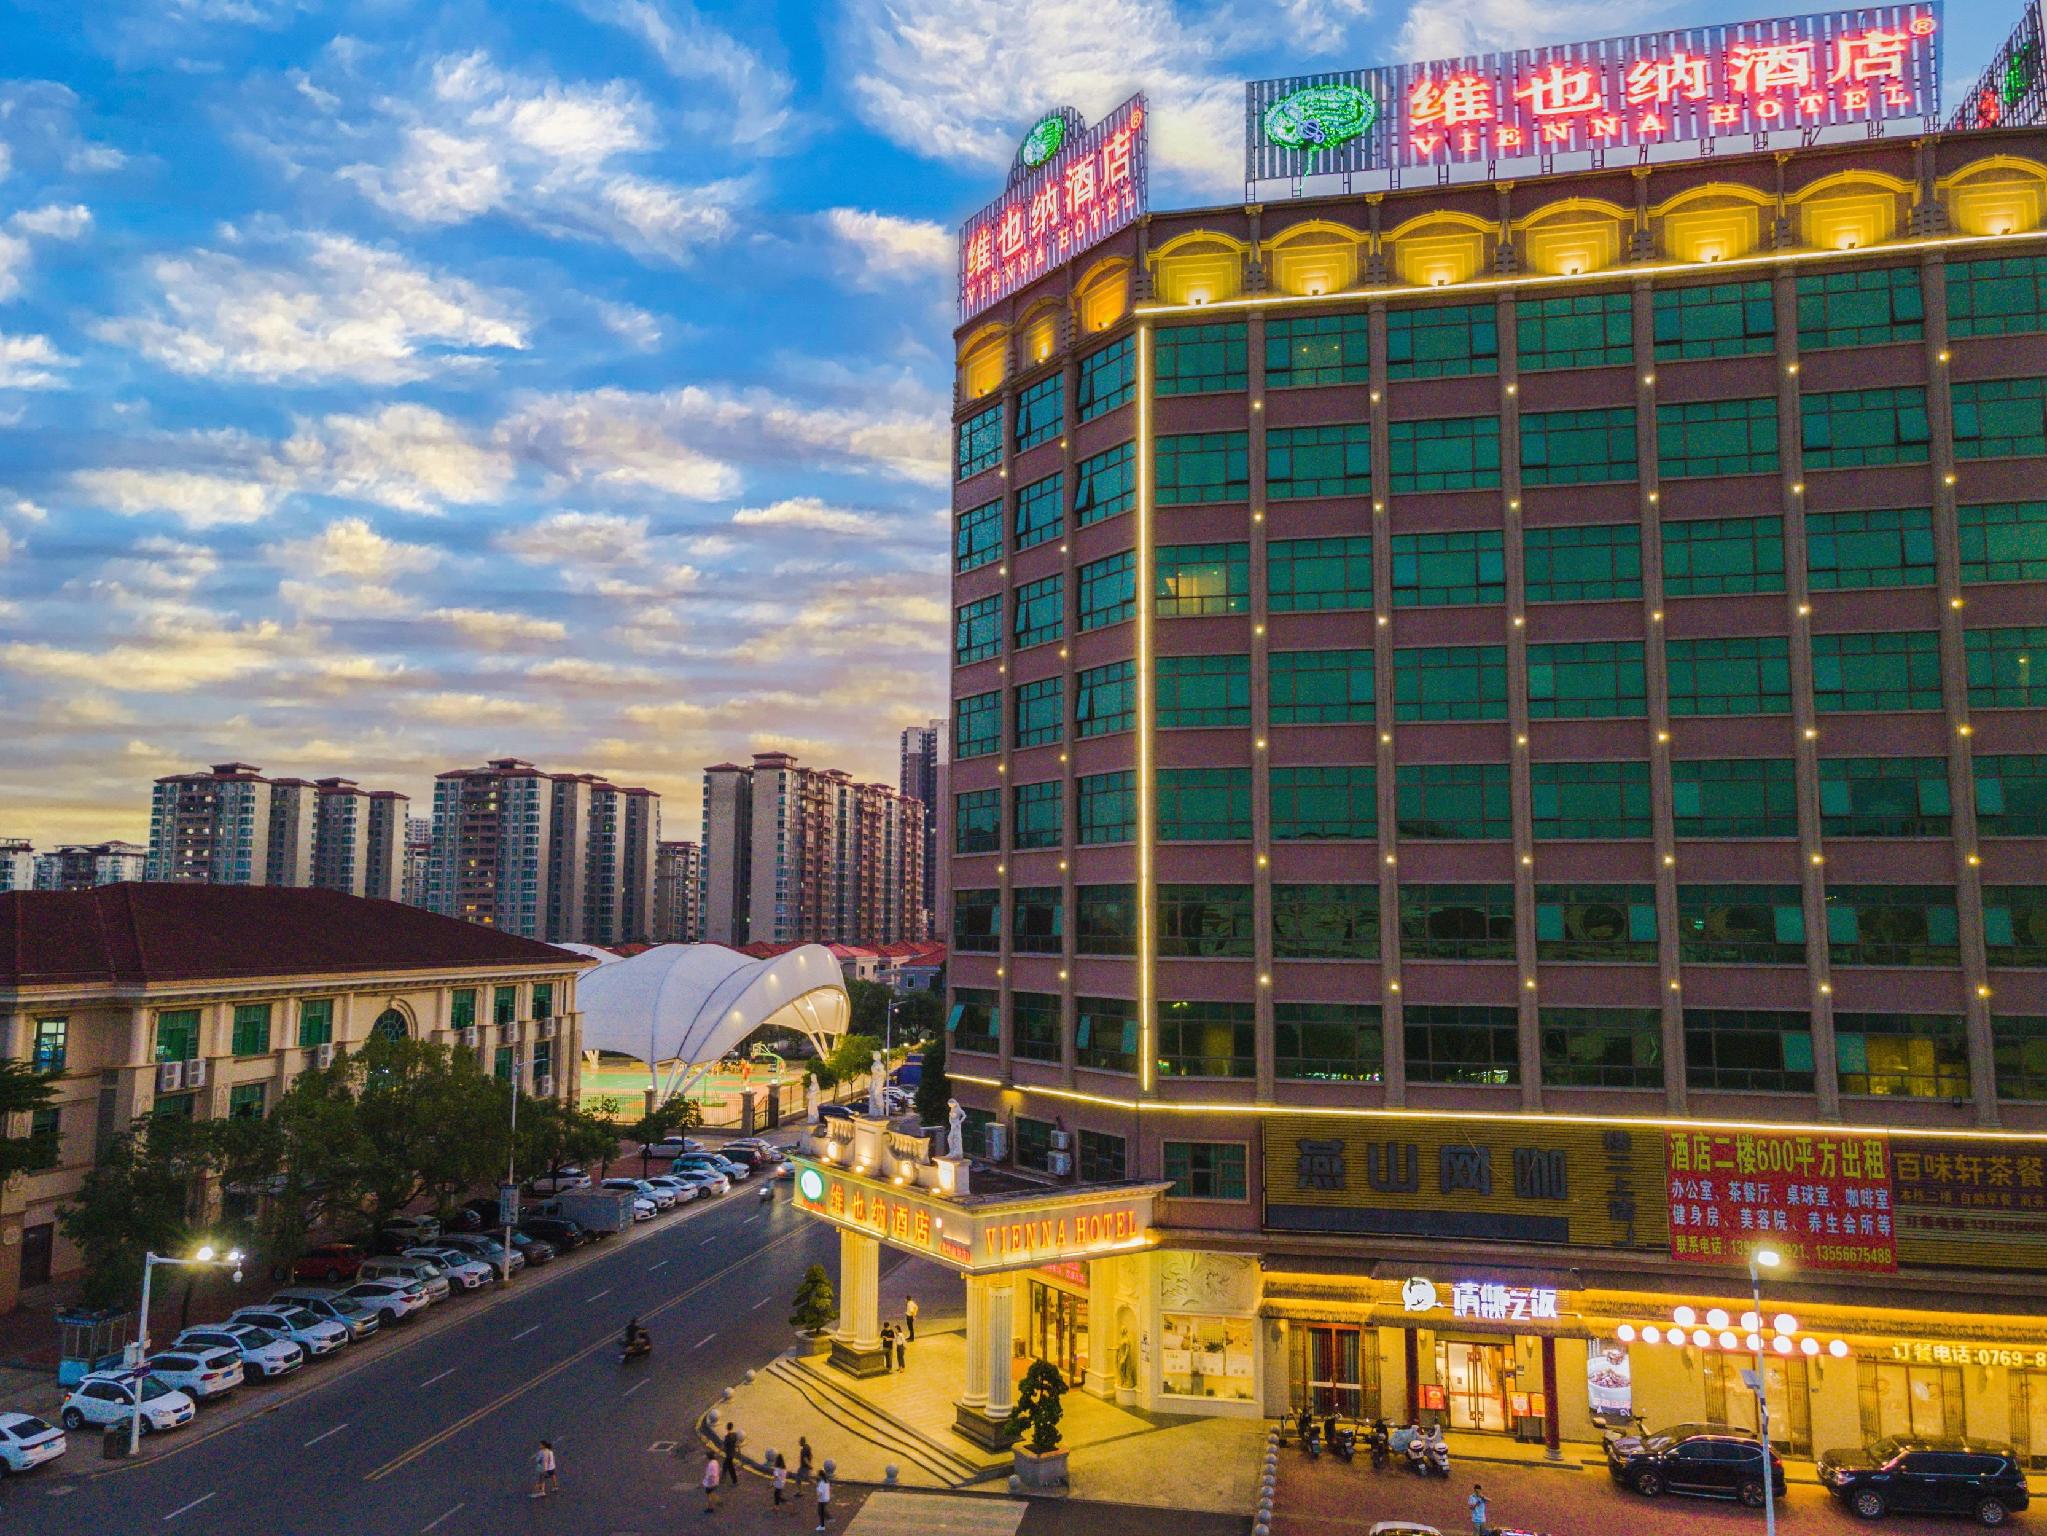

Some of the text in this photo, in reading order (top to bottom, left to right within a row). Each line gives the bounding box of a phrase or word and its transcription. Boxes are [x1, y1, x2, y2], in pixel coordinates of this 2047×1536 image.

[1409, 32, 1908, 127] 维也纳酒店
[1415, 84, 1912, 154] VIENNA HOTEL
[967, 132, 1132, 277] 维也纳酒店
[967, 185, 1134, 304] VIENNA HOTEL
[1297, 1138, 1567, 1200] 燕山网咖
[1670, 1132, 1886, 1179] 酒店二楼600平方出租
[1893, 1153, 2044, 1187] 百味轩茶餐
[830, 1184, 930, 1245] 维也纳酒店
[985, 1217, 1066, 1255] VIENNA
[1075, 1210, 1138, 1243] HOTEL
